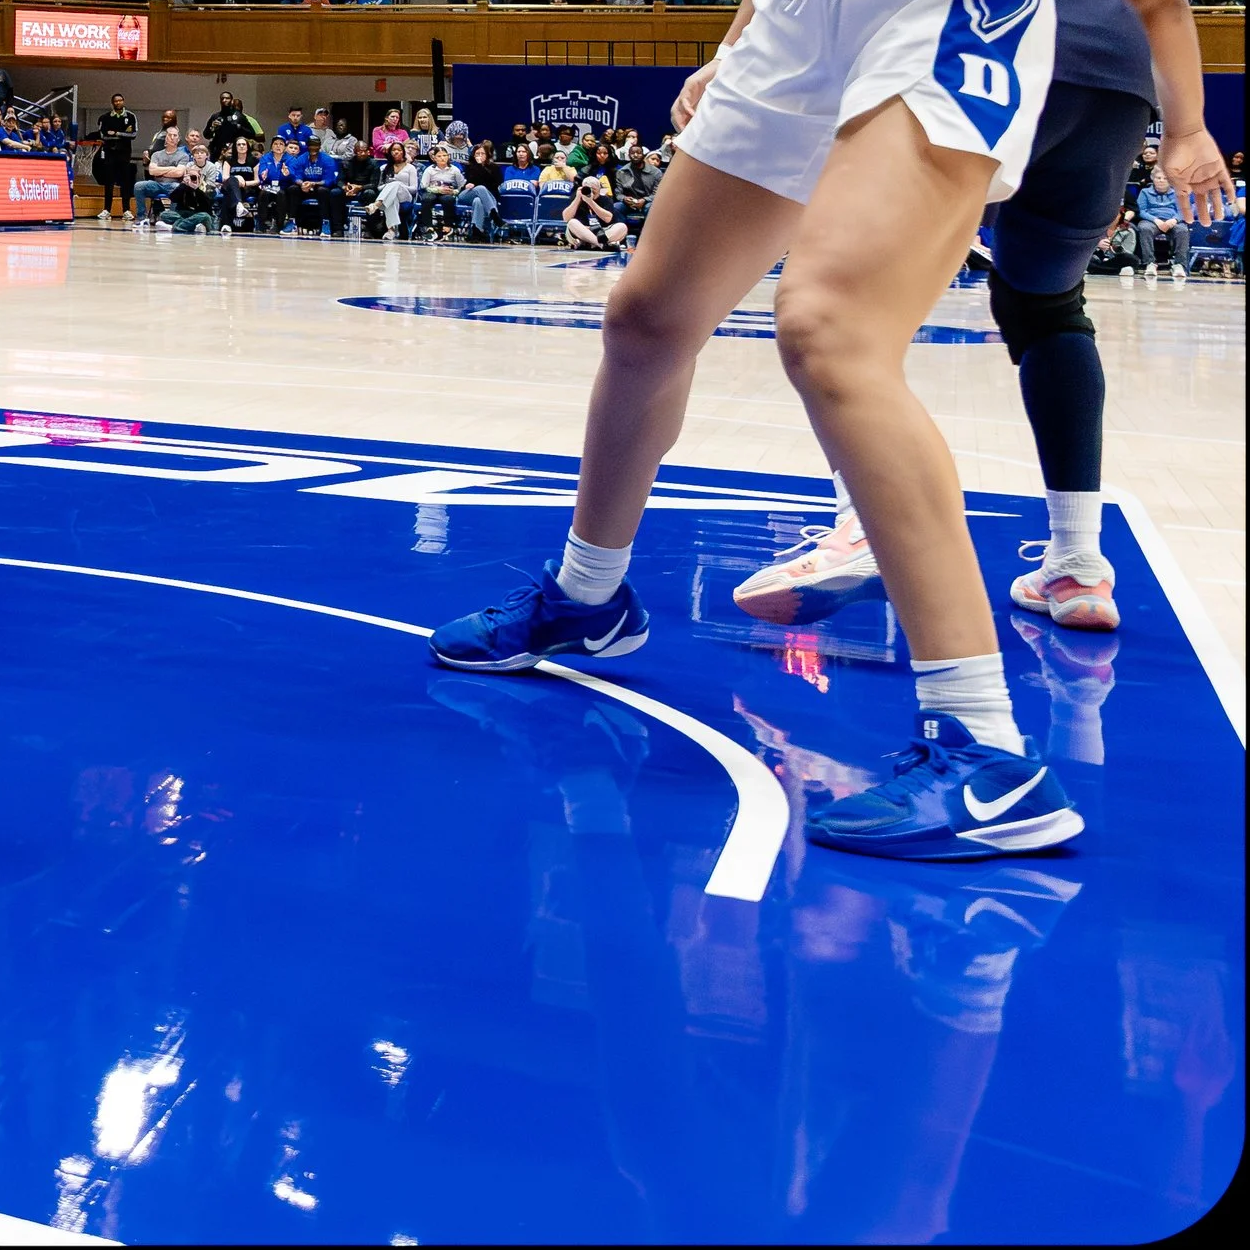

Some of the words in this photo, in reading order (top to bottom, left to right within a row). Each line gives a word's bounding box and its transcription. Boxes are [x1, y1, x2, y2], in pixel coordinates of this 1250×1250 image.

[22, 21, 55, 38] FAN
[58, 23, 111, 40] WORK
[22, 37, 32, 46] IS
[33, 38, 77, 48] THIRSTY
[79, 40, 111, 50] WORK
[958, 53, 1011, 107] D
[537, 107, 611, 127] SISTERHOOD
[505, 180, 529, 191] DUKE
[547, 180, 572, 192] DUKE
